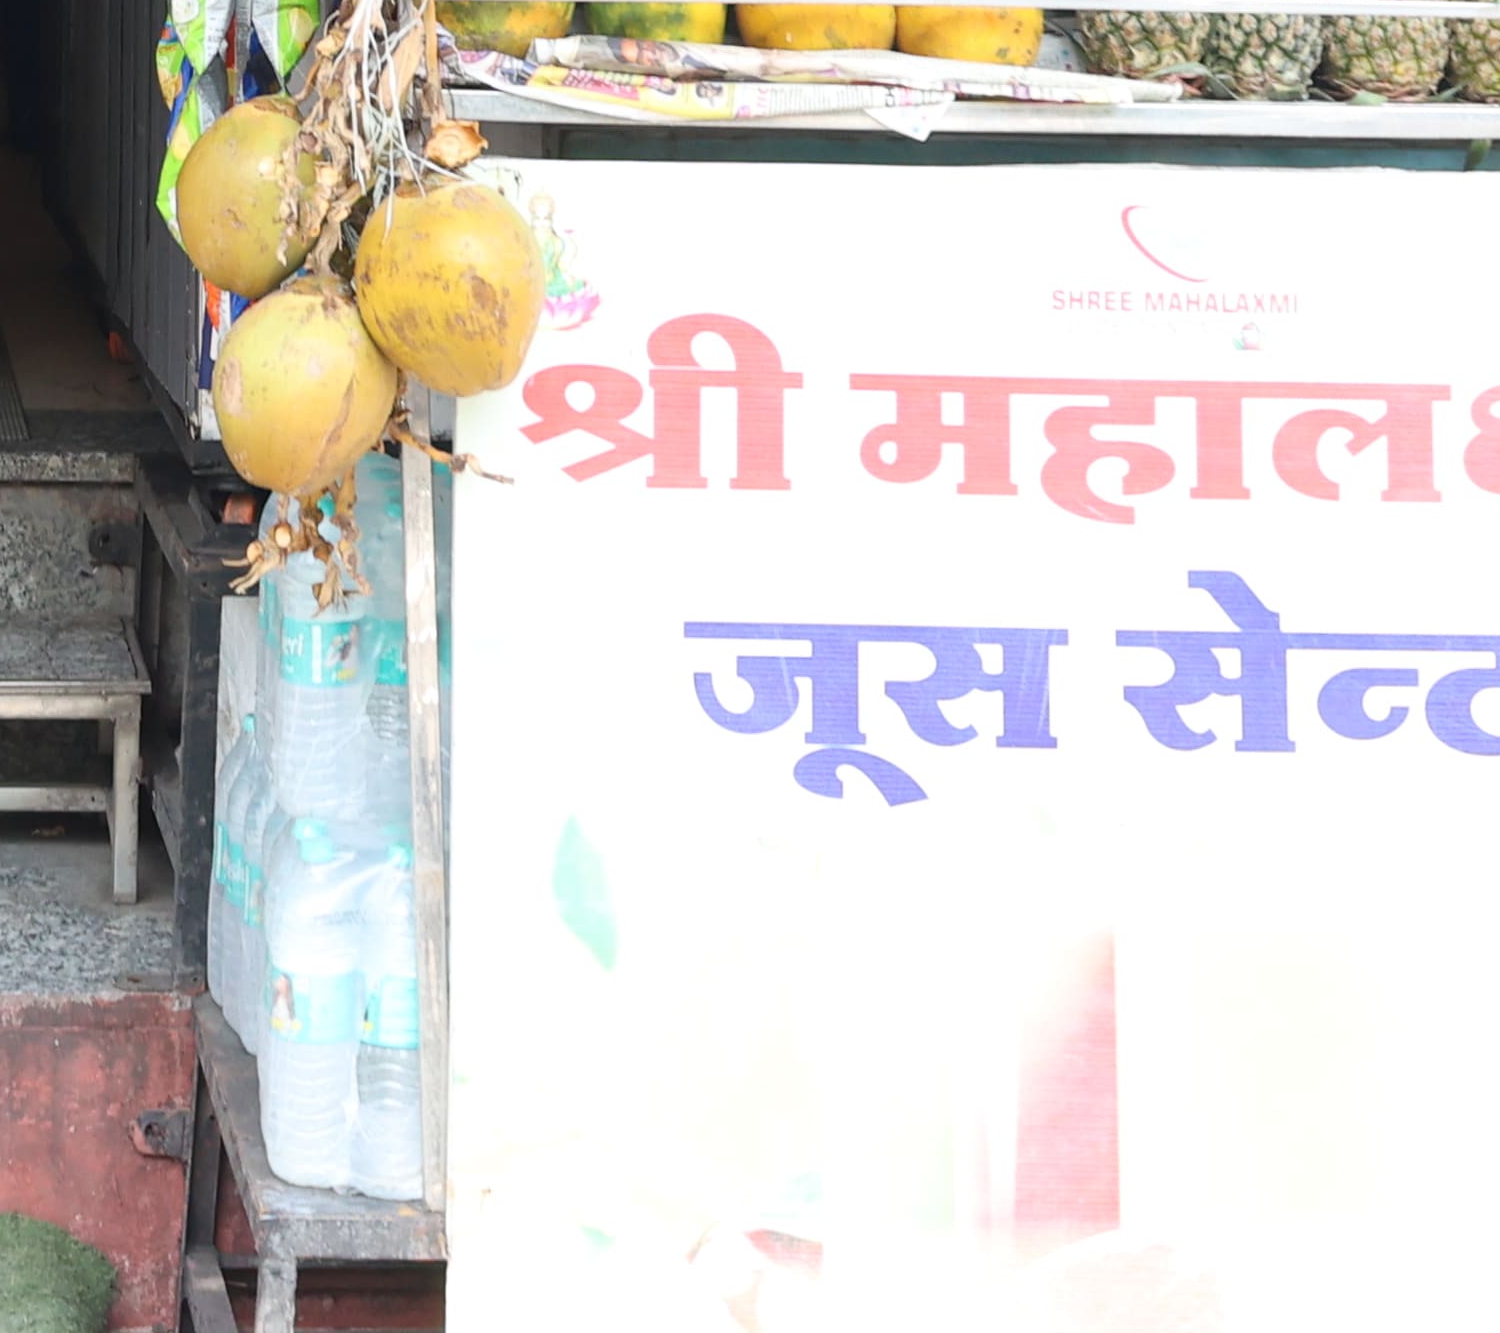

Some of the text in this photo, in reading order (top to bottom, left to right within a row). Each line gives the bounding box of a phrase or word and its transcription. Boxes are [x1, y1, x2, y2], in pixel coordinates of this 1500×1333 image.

[1051, 288, 1300, 315] SHREE MAHALAXMI
[516, 310, 805, 494] श्री
[683, 618, 1069, 807] जूस
